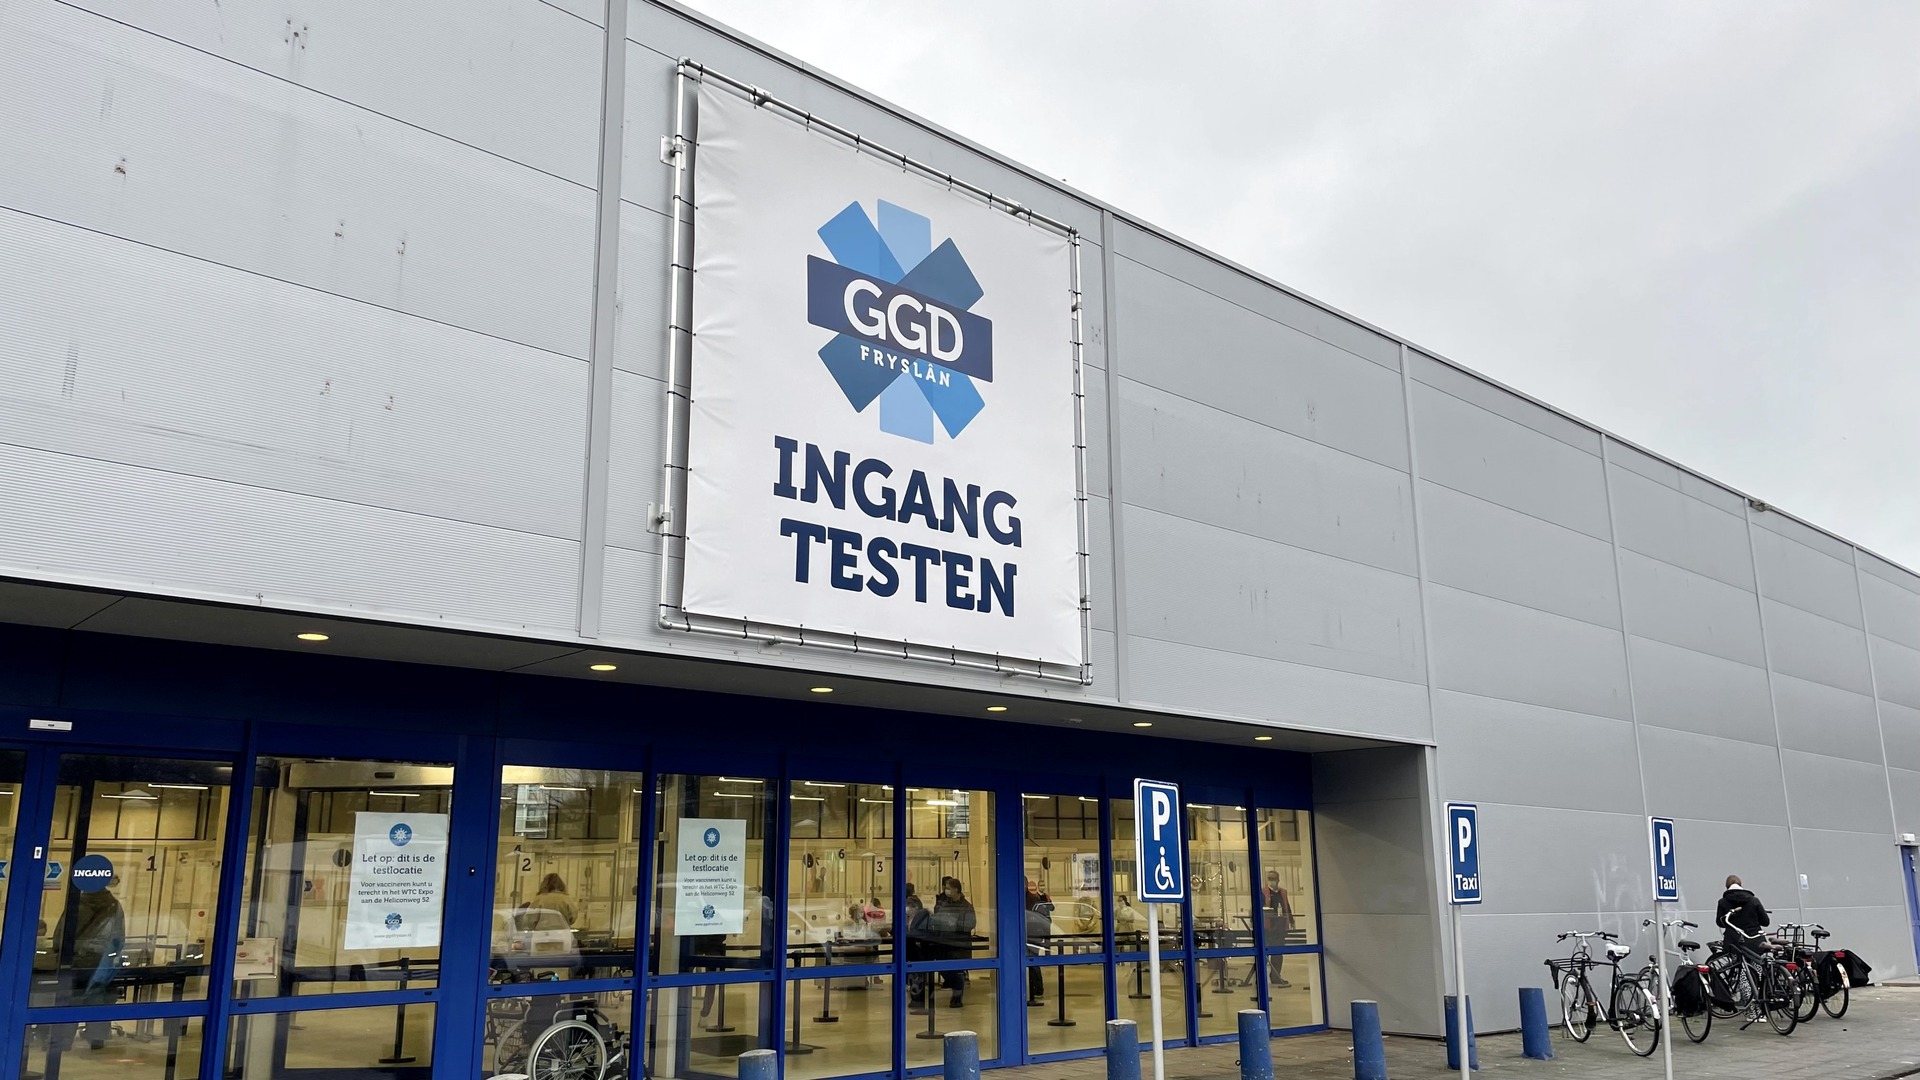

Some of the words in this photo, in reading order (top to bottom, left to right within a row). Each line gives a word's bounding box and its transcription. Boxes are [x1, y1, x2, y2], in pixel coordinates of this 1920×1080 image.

[843, 278, 965, 363] GGD
[860, 344, 951, 388] FRYSLÂN
[773, 435, 1023, 548] INGANG
[780, 518, 1018, 618] TESTEN
[1151, 790, 1171, 841] P
[1457, 817, 1472, 863] P
[838, 848, 845, 860] 6
[1659, 828, 1670, 867] P
[362, 854, 377, 863] Let
[379, 855, 395, 864] op:
[397, 854, 410, 863] dit
[412, 854, 421, 863] is
[422, 854, 435, 863] de
[684, 854, 696, 862] Let
[710, 854, 720, 862] dit
[720, 854, 727, 862] is
[728, 854, 738, 862] de
[953, 850, 960, 861] 7
[146, 855, 157, 871] 1
[373, 865, 423, 875] testlocatie
[522, 858, 531, 871] 2
[692, 864, 729, 872] testlocatie
[877, 861, 883, 872] 3
[73, 869, 112, 877] INGANG
[1455, 873, 1478, 890] Taxi
[1658, 876, 1676, 890] Taxi
